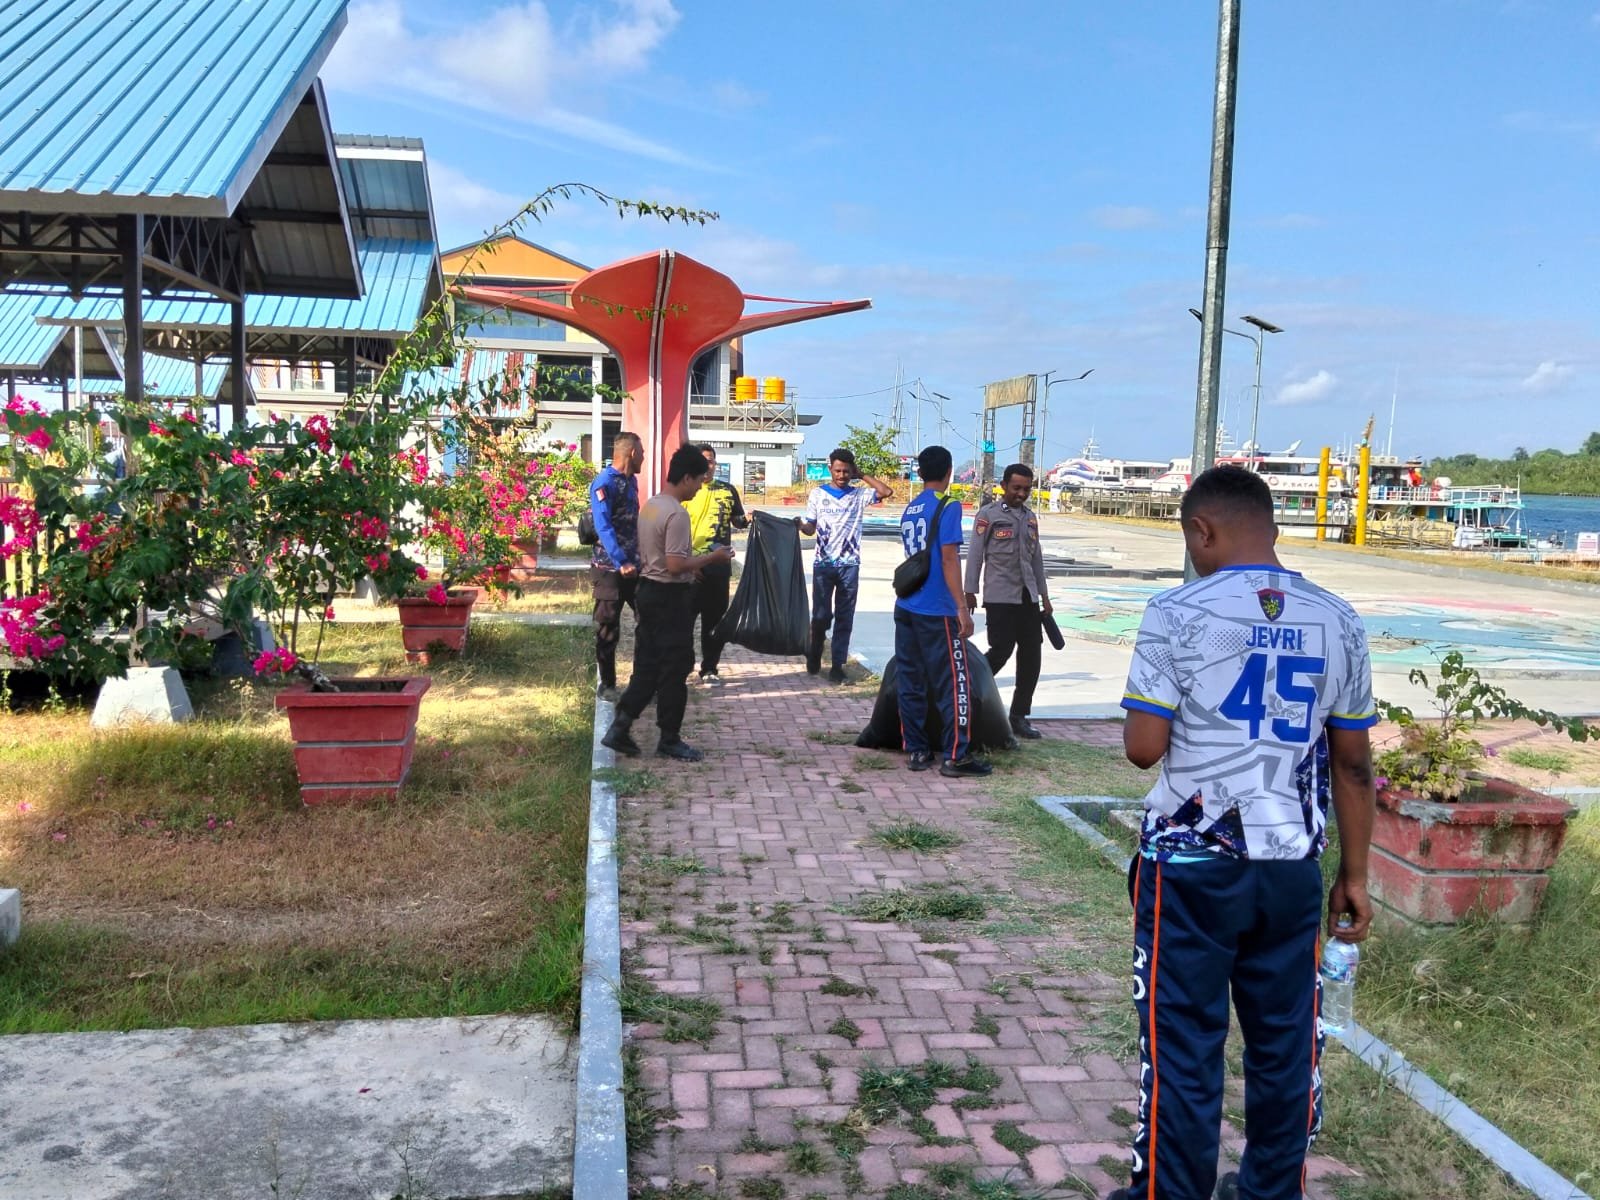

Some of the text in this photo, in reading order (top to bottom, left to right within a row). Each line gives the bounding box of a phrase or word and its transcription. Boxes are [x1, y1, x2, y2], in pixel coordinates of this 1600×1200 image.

[901, 517, 927, 560] 33
[1245, 625, 1303, 651] JEVRI
[952, 639, 968, 726] POLAIRUD
[1217, 652, 1328, 743] 45
